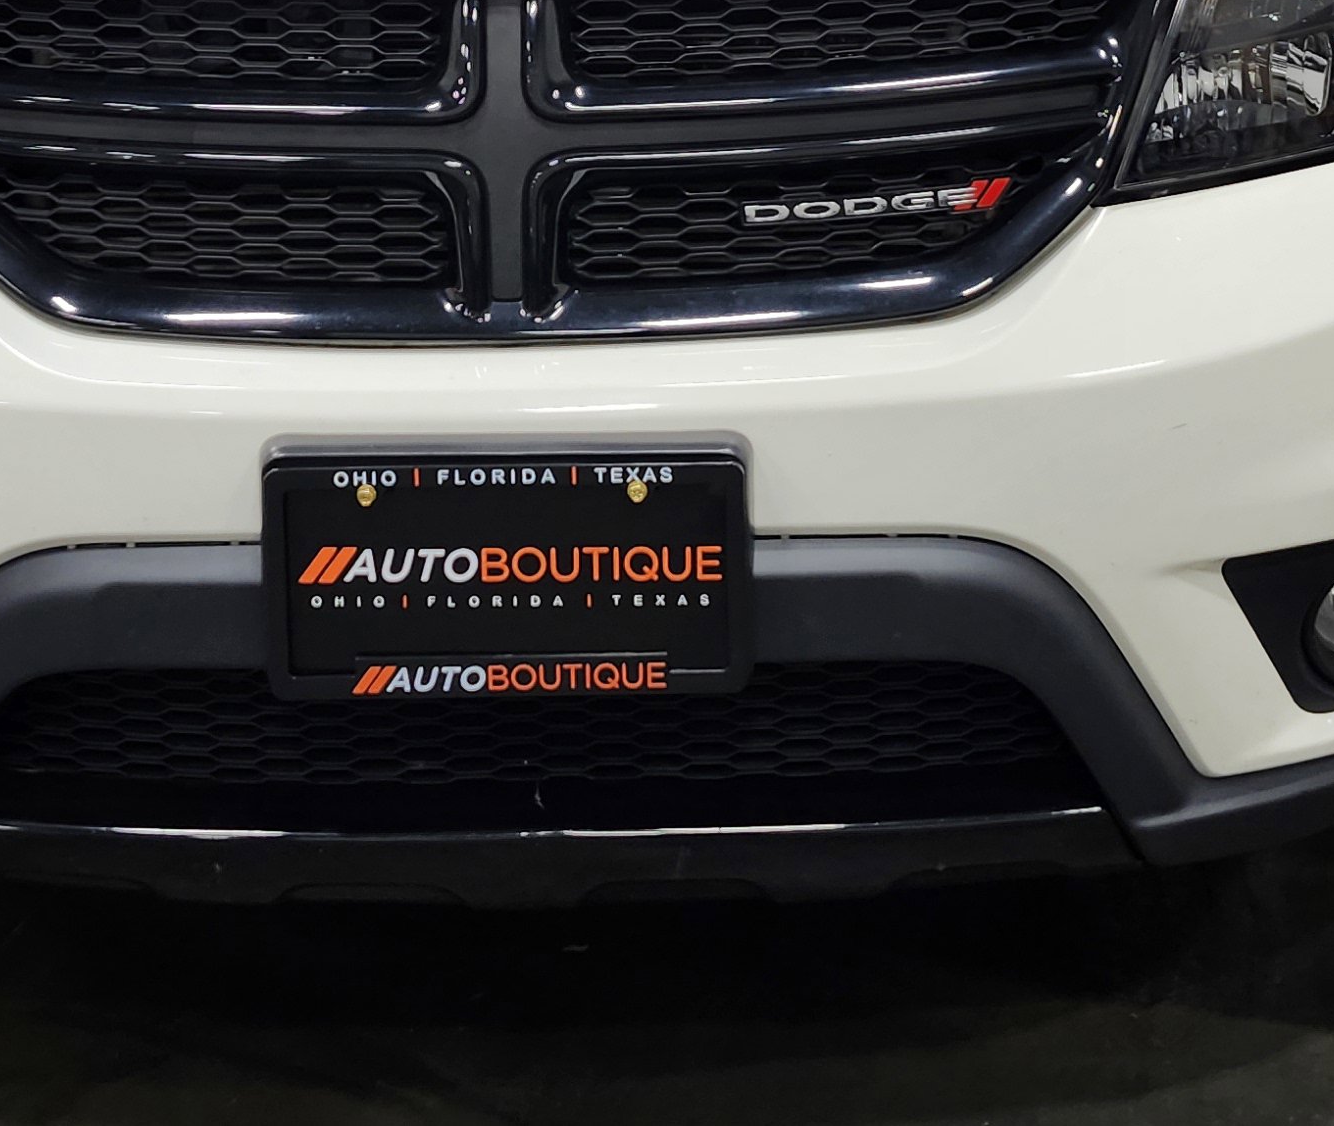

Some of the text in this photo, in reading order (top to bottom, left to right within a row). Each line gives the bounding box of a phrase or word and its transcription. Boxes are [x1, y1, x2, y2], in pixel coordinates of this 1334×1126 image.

[743, 187, 978, 223] DODGE
[333, 465, 674, 488] OHIO FLORIDA TEXAS
[343, 545, 723, 585] AUTOBOUTIQUE
[311, 593, 711, 609] OHIO FLORIDA TEXAS
[385, 661, 668, 694] AUTOBOUTIQUE
